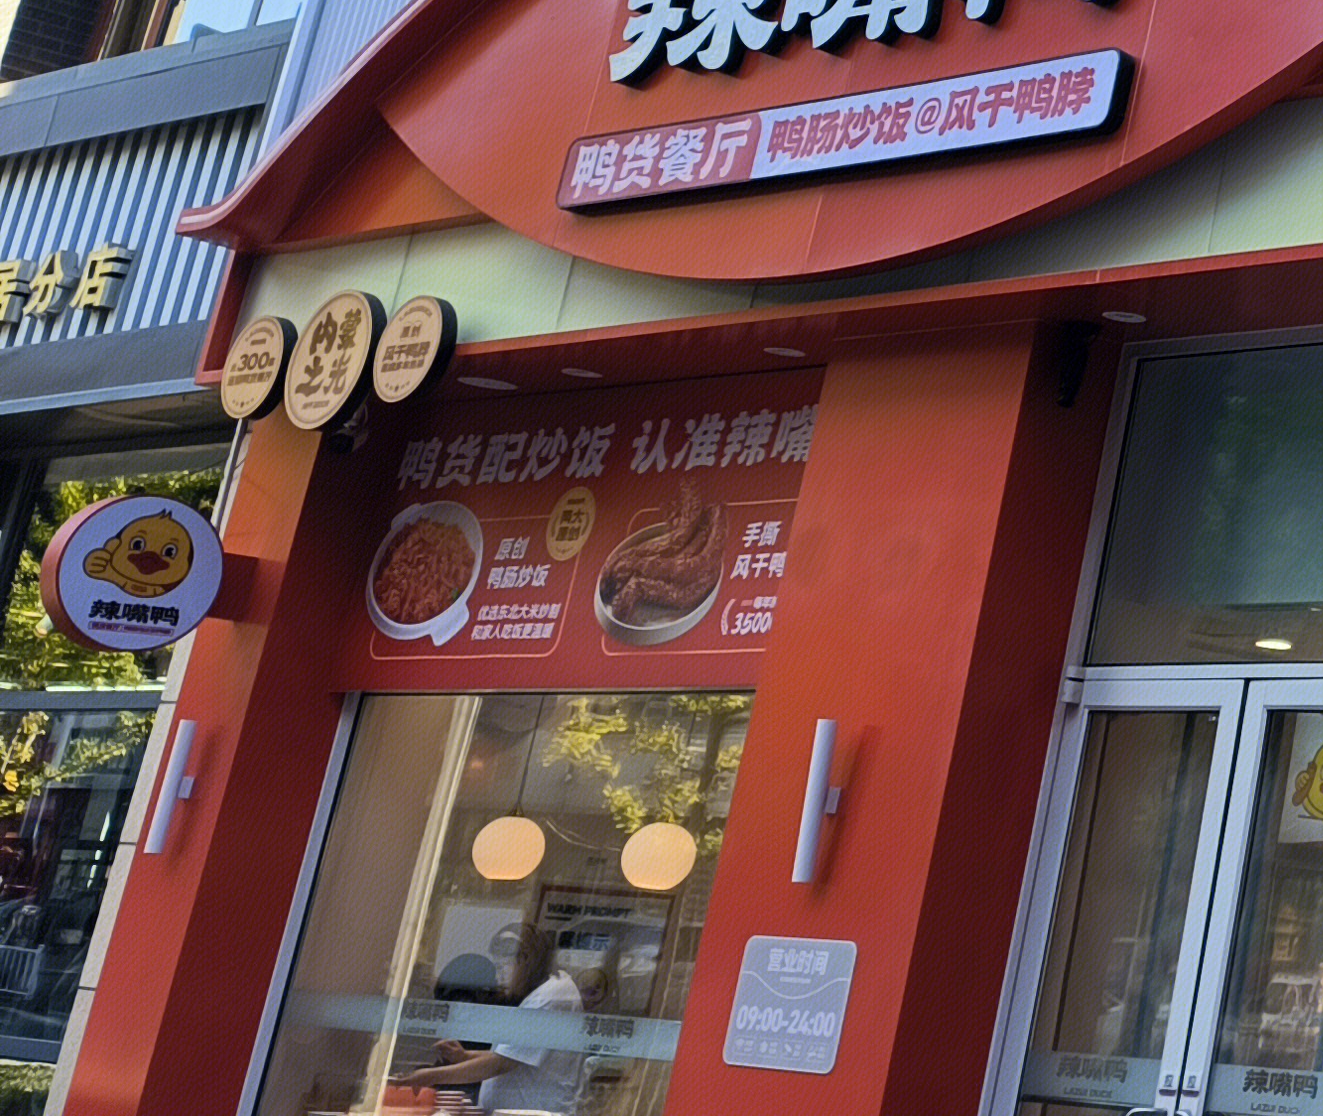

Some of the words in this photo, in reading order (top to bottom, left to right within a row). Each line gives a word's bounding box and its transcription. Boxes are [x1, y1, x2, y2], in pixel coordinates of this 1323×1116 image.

[766, 66, 1096, 163] 鸭肠炒饭@风干鸭脖
[570, 118, 755, 197] 鸭货餐厅
[397, 421, 616, 491] 鸭货配炒饭
[494, 536, 531, 561] 原创
[742, 521, 783, 548] 手撕
[486, 564, 551, 590] 鸭肠炒饭
[88, 599, 180, 626] 辣嘴鸭
[767, 948, 830, 976] 营业时间
[735, 1004, 836, 1037] 09:00-24:00
[1056, 1055, 1129, 1084] 辣嘴鸭
[1242, 1068, 1319, 1100] 辣嘴鸭
